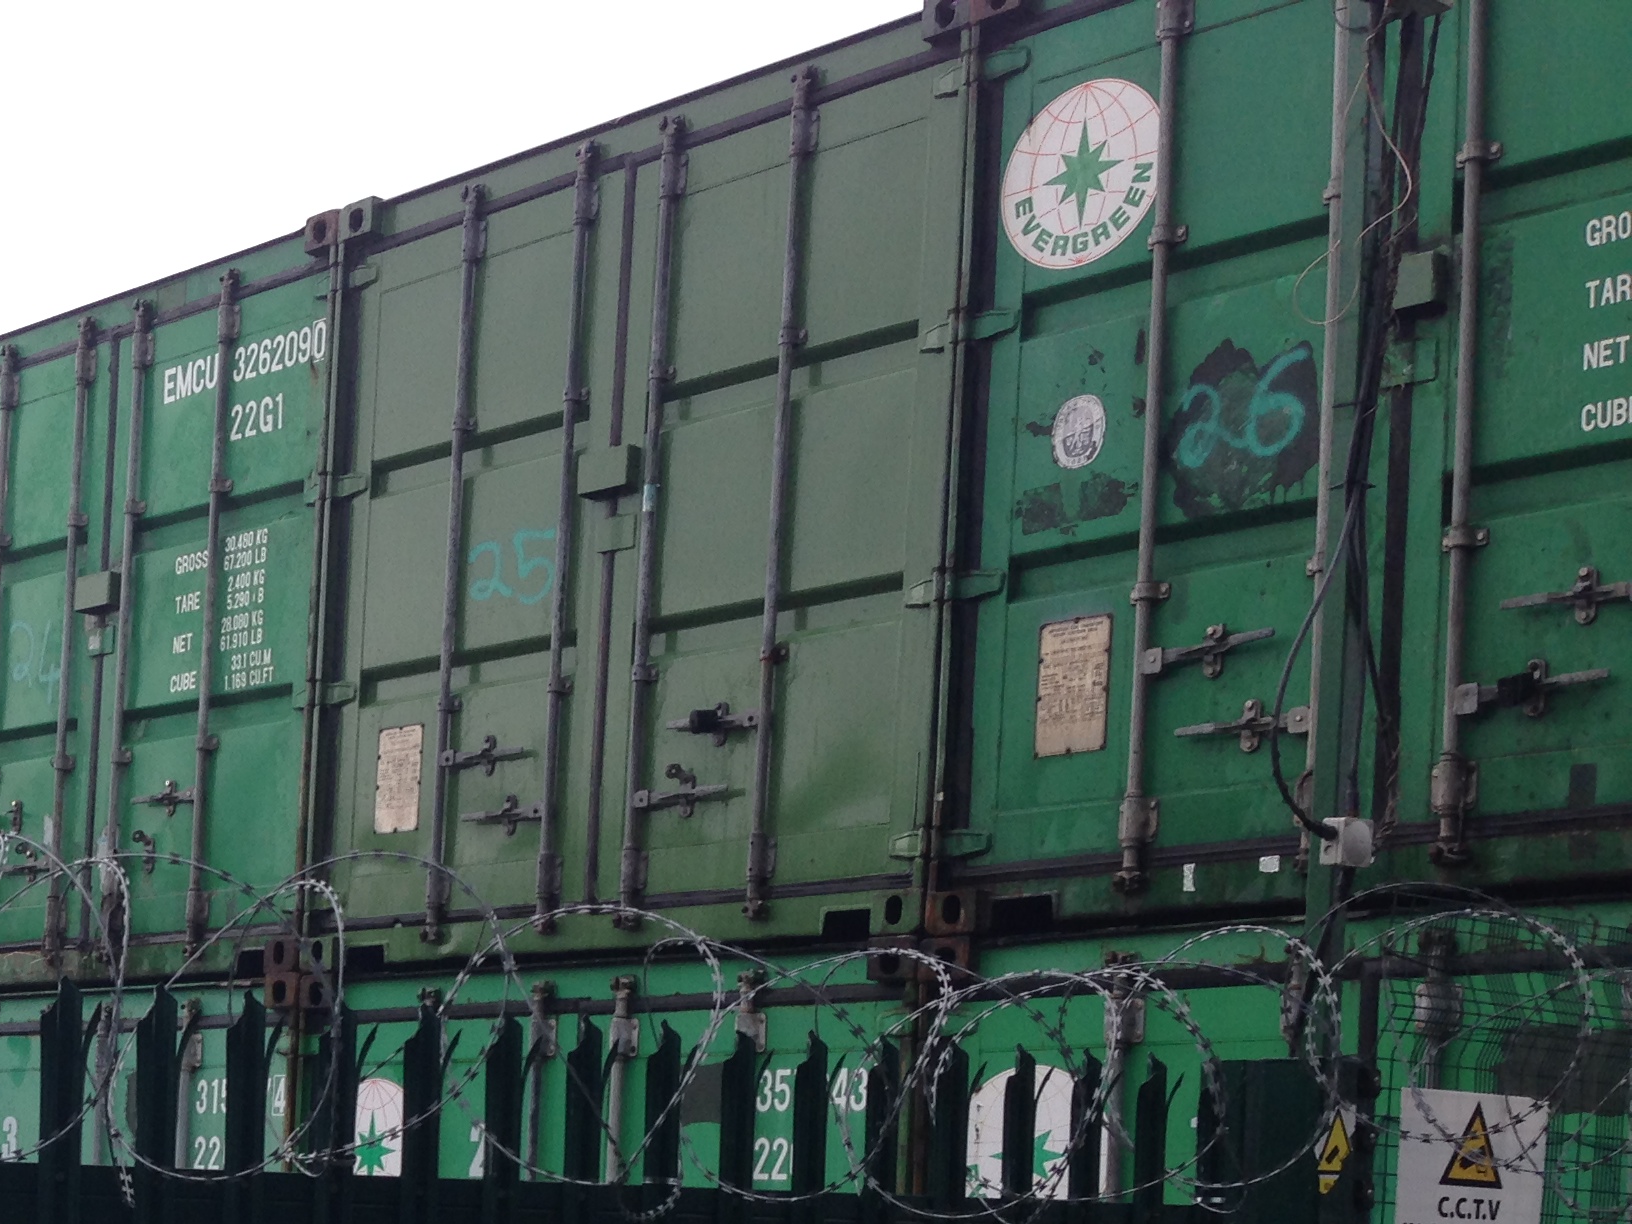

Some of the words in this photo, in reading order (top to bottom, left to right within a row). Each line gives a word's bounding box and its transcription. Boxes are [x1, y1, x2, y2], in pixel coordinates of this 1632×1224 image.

[1012, 159, 1155, 258] EVERGREEN
[1585, 210, 1632, 247] GRO
[1585, 273, 1632, 309] TAR
[163, 352, 220, 405] EMCU
[232, 319, 327, 383] 3262090
[1582, 334, 1631, 371] NET
[230, 392, 284, 442] 22G1
[1171, 346, 1311, 468] 26
[1581, 395, 1632, 432] CUB
[255, 528, 268, 545] KG
[175, 550, 209, 575] GROSS
[254, 547, 267, 564] LB
[468, 528, 559, 603] 25
[253, 568, 266, 586] KG
[175, 591, 201, 614] TARE
[251, 610, 264, 626] KG
[172, 633, 193, 654] NET
[250, 628, 263, 645] LB
[169, 670, 197, 693] CUBE
[1, 1116, 18, 1162] 3
[193, 1135, 221, 1170] 22
[752, 1136, 790, 1181] 22
[1437, 1196, 1501, 1221] C.C.T.V
